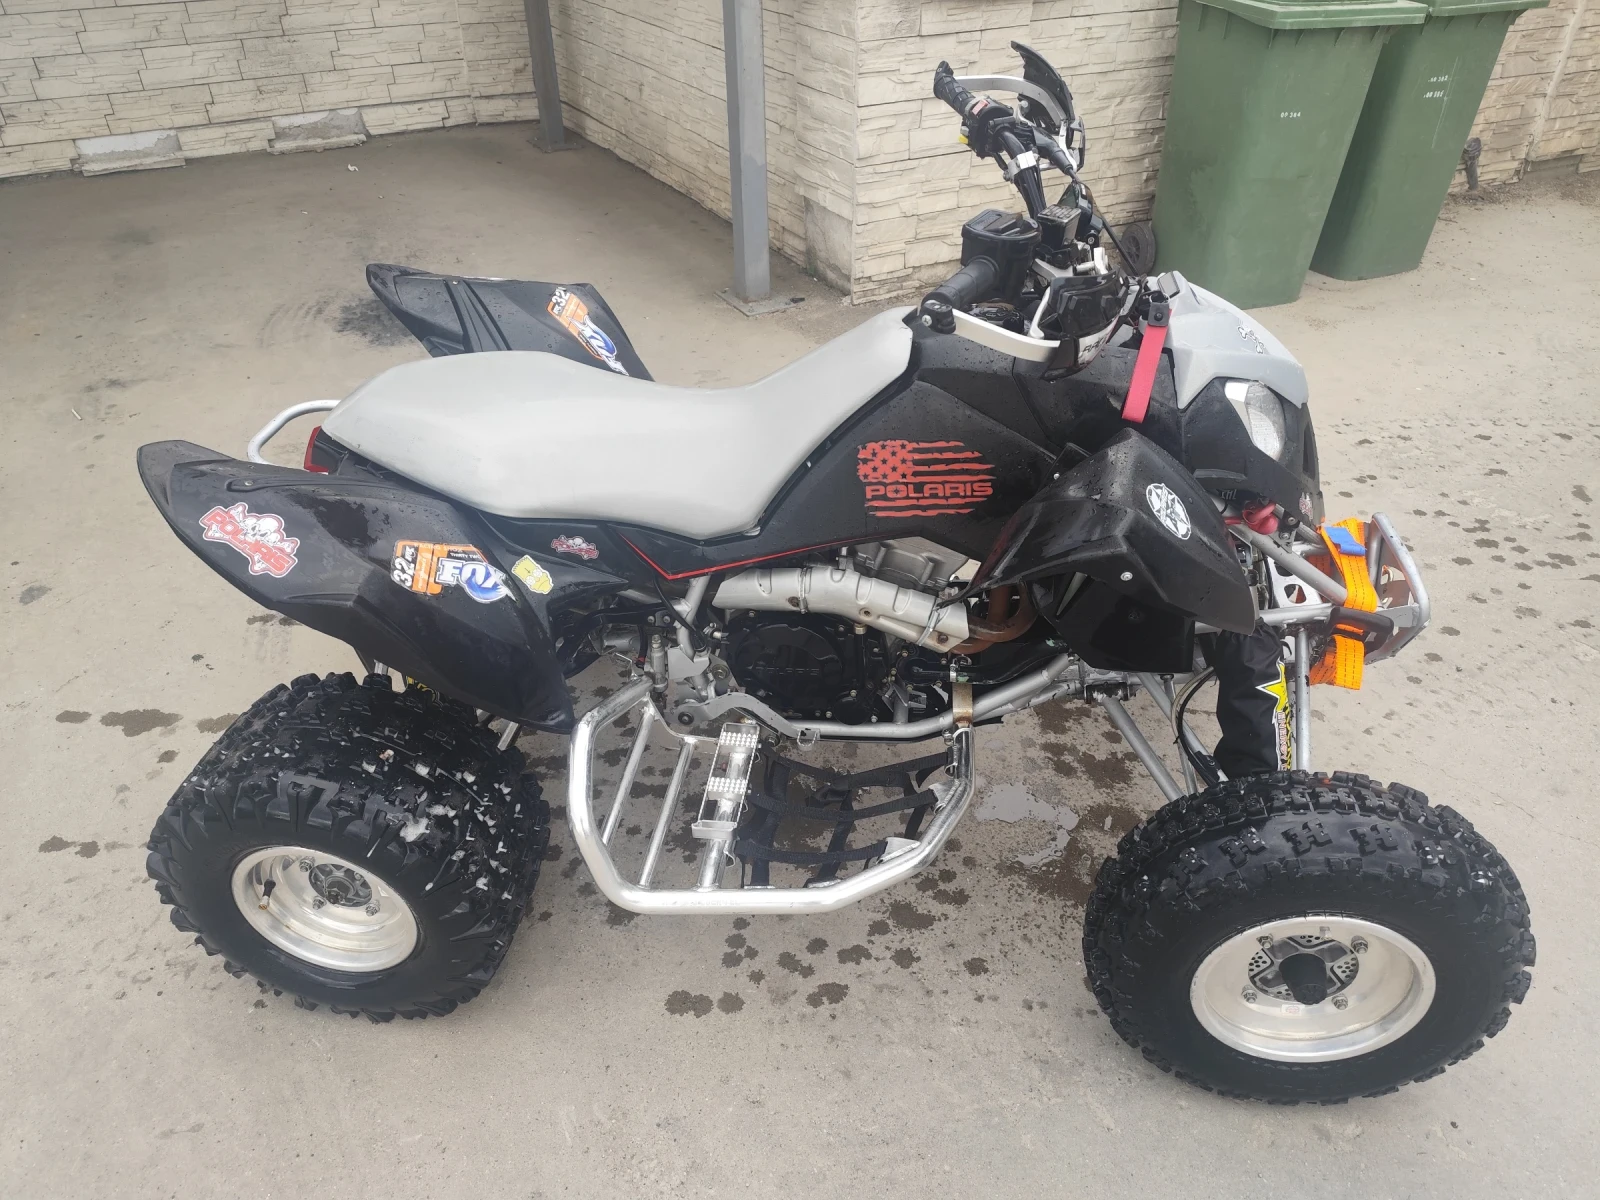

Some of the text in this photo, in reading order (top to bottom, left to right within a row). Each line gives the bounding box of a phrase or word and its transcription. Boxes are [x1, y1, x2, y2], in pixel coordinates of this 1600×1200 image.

[552, 288, 570, 307] 32
[865, 482, 993, 499] POLARIS
[204, 510, 292, 573] POLARIS
[393, 556, 415, 587] 32
[434, 557, 511, 592] FOX
